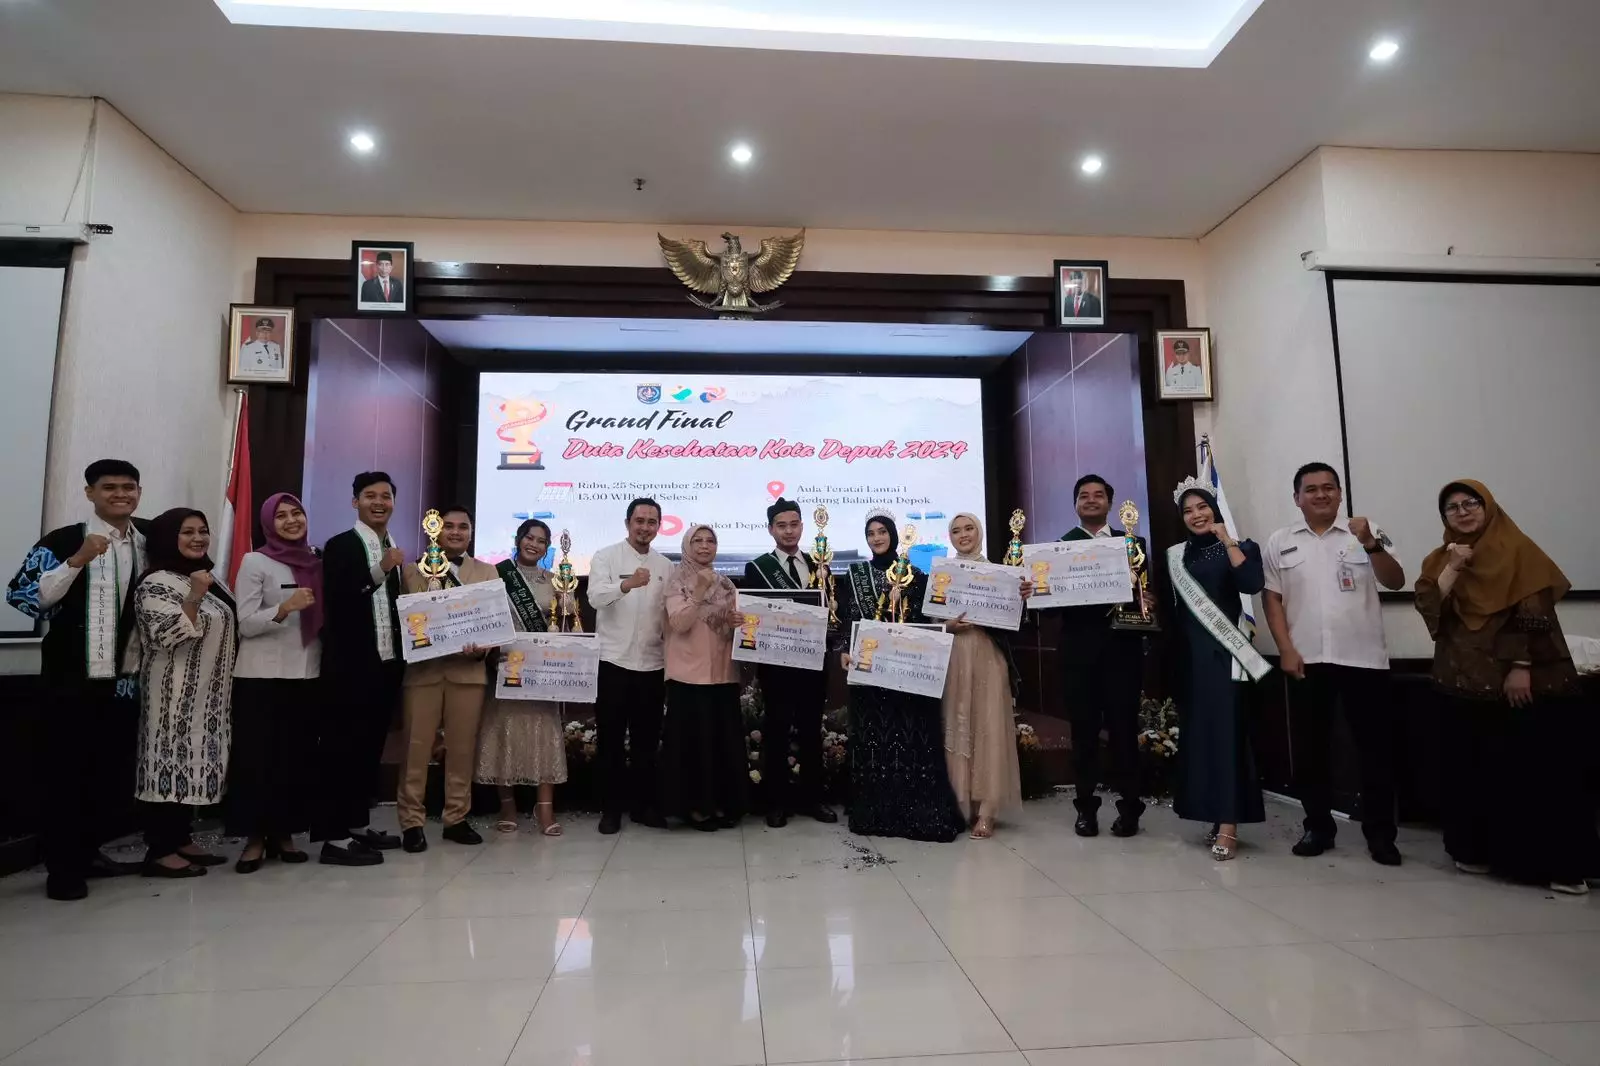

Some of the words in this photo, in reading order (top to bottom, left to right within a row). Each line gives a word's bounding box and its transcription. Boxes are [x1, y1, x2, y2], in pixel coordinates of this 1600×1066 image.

[565, 409, 659, 432] Grand
[656, 409, 734, 431] Final
[562, 438, 624, 459] Duta
[627, 438, 757, 459] Kesehatan
[759, 438, 815, 459] Kota
[818, 438, 897, 463] Depok
[897, 440, 968, 460] 2024
[578, 482, 610, 491] Rabu,
[629, 482, 690, 491] September
[797, 485, 822, 493] Aula
[826, 485, 864, 493] Teratai
[866, 485, 901, 493] Lantai
[660, 493, 698, 501] Selesai
[796, 496, 839, 505] Gedung
[842, 496, 893, 504] Balaikota
[896, 496, 931, 505] Depok
[447, 610, 473, 620] Juara
[474, 607, 481, 615] 2
[1179, 575, 1204, 608] KESEHATAN
[1200, 603, 1216, 622] JAWA
[1213, 618, 1231, 638] BARAT
[1227, 633, 1244, 650] 2023
[97, 586, 106, 660] KESEHATAN
[433, 632, 450, 643] Rp.
[542, 659, 566, 667] Juara
[524, 677, 539, 686] Rp.
